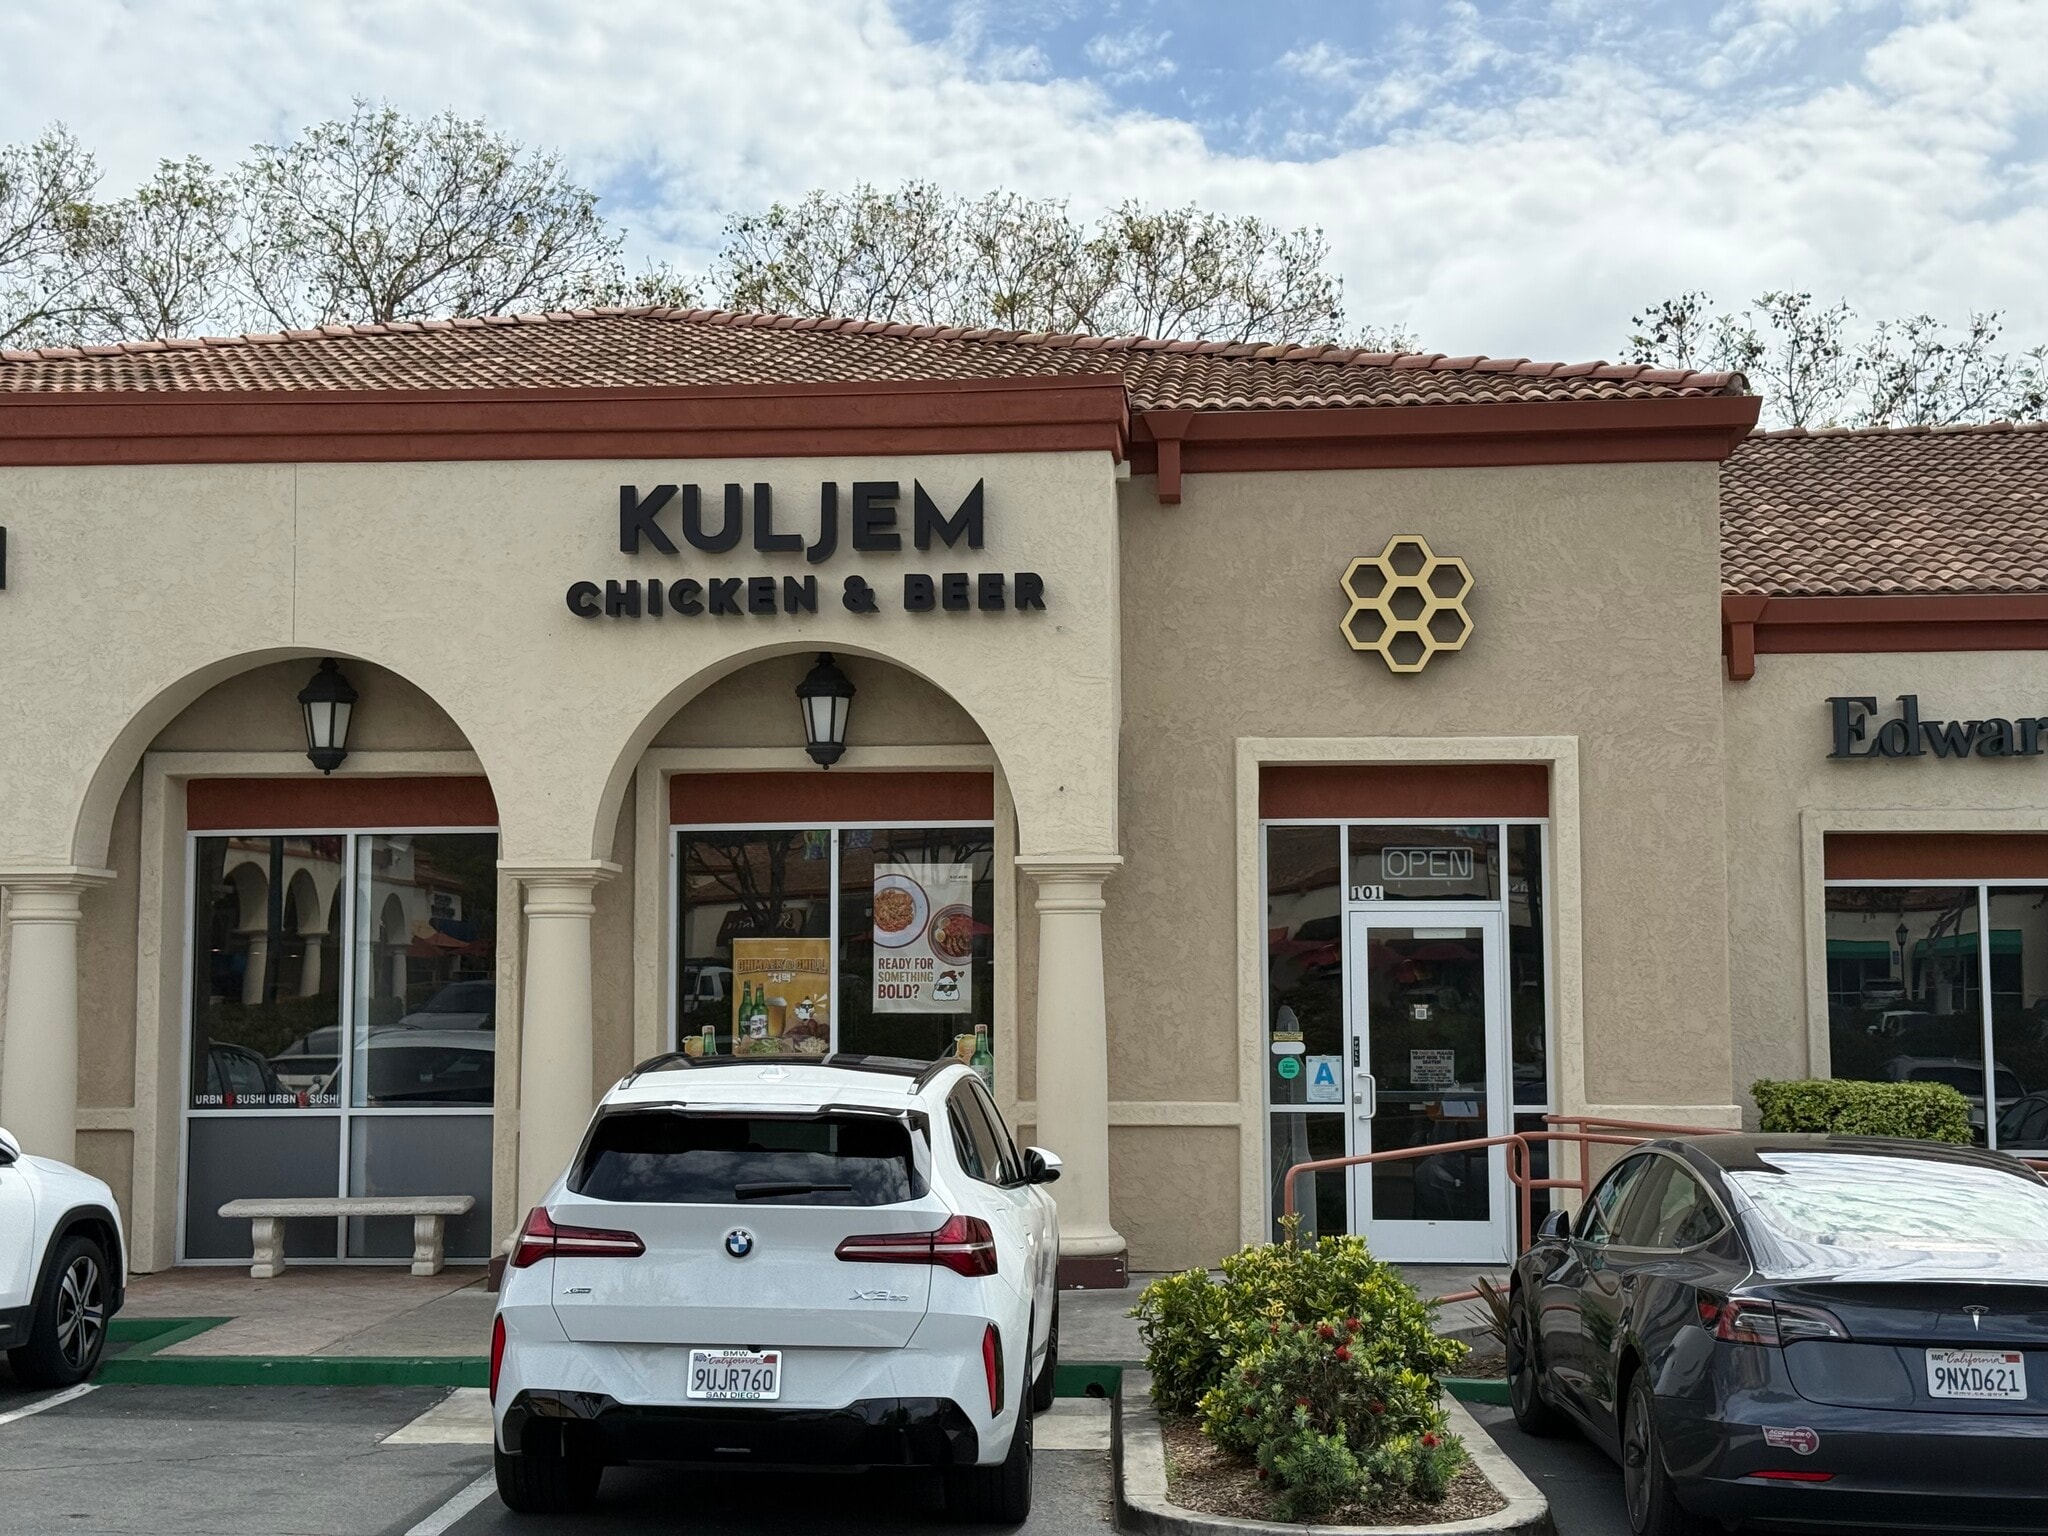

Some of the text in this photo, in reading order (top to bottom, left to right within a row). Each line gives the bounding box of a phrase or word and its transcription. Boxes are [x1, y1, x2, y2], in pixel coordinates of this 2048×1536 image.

[620, 477, 985, 564] KULJEM
[566, 571, 1046, 618] CHICKEN & BEER
[1387, 851, 1469, 877] OPEN
[1354, 886, 1382, 900] 101
[878, 957, 934, 970] READY FOR
[878, 971, 934, 983] SOMETHING
[878, 983, 920, 999] BOLD?
[1314, 1062, 1335, 1085] A
[195, 1094, 339, 1104] URBN SUSHI URBN SUSHI
[1946, 1352, 2006, 1367] California
[695, 1368, 773, 1391] 9UJR760
[1935, 1367, 2020, 1392] 9NXD621
[706, 1391, 760, 1399] SAN DIEGO
